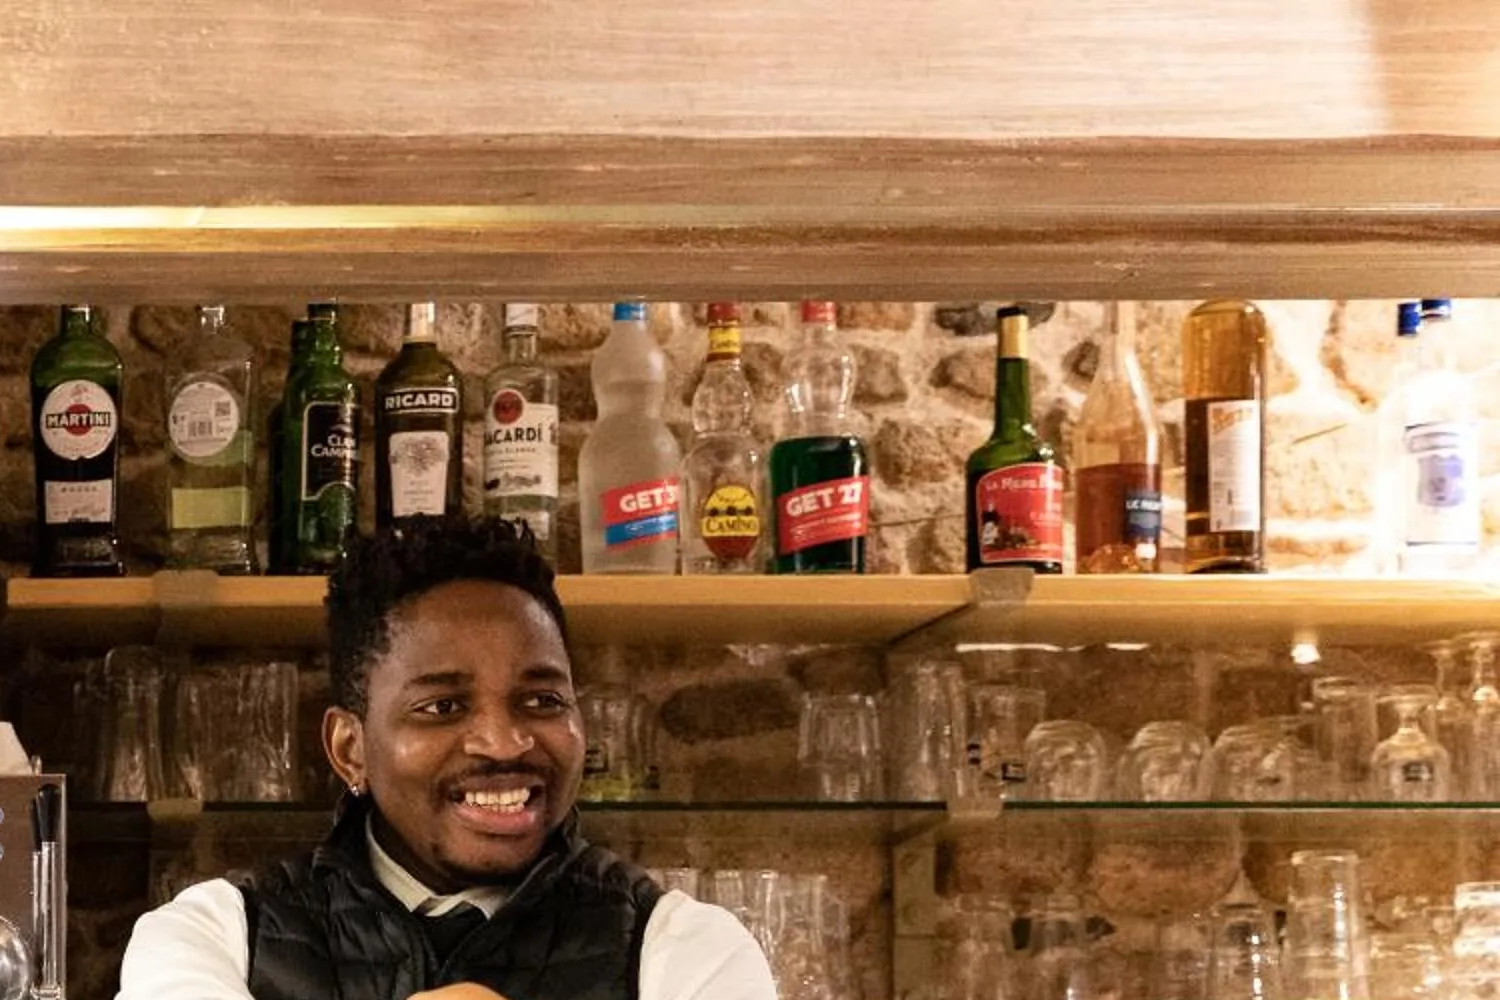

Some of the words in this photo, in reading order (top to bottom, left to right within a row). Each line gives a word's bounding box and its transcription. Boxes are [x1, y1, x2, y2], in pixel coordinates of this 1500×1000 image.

[385, 393, 454, 409] RICARD
[46, 412, 111, 428] MARTINI
[620, 488, 664, 512] GET
[786, 487, 835, 517] GET
